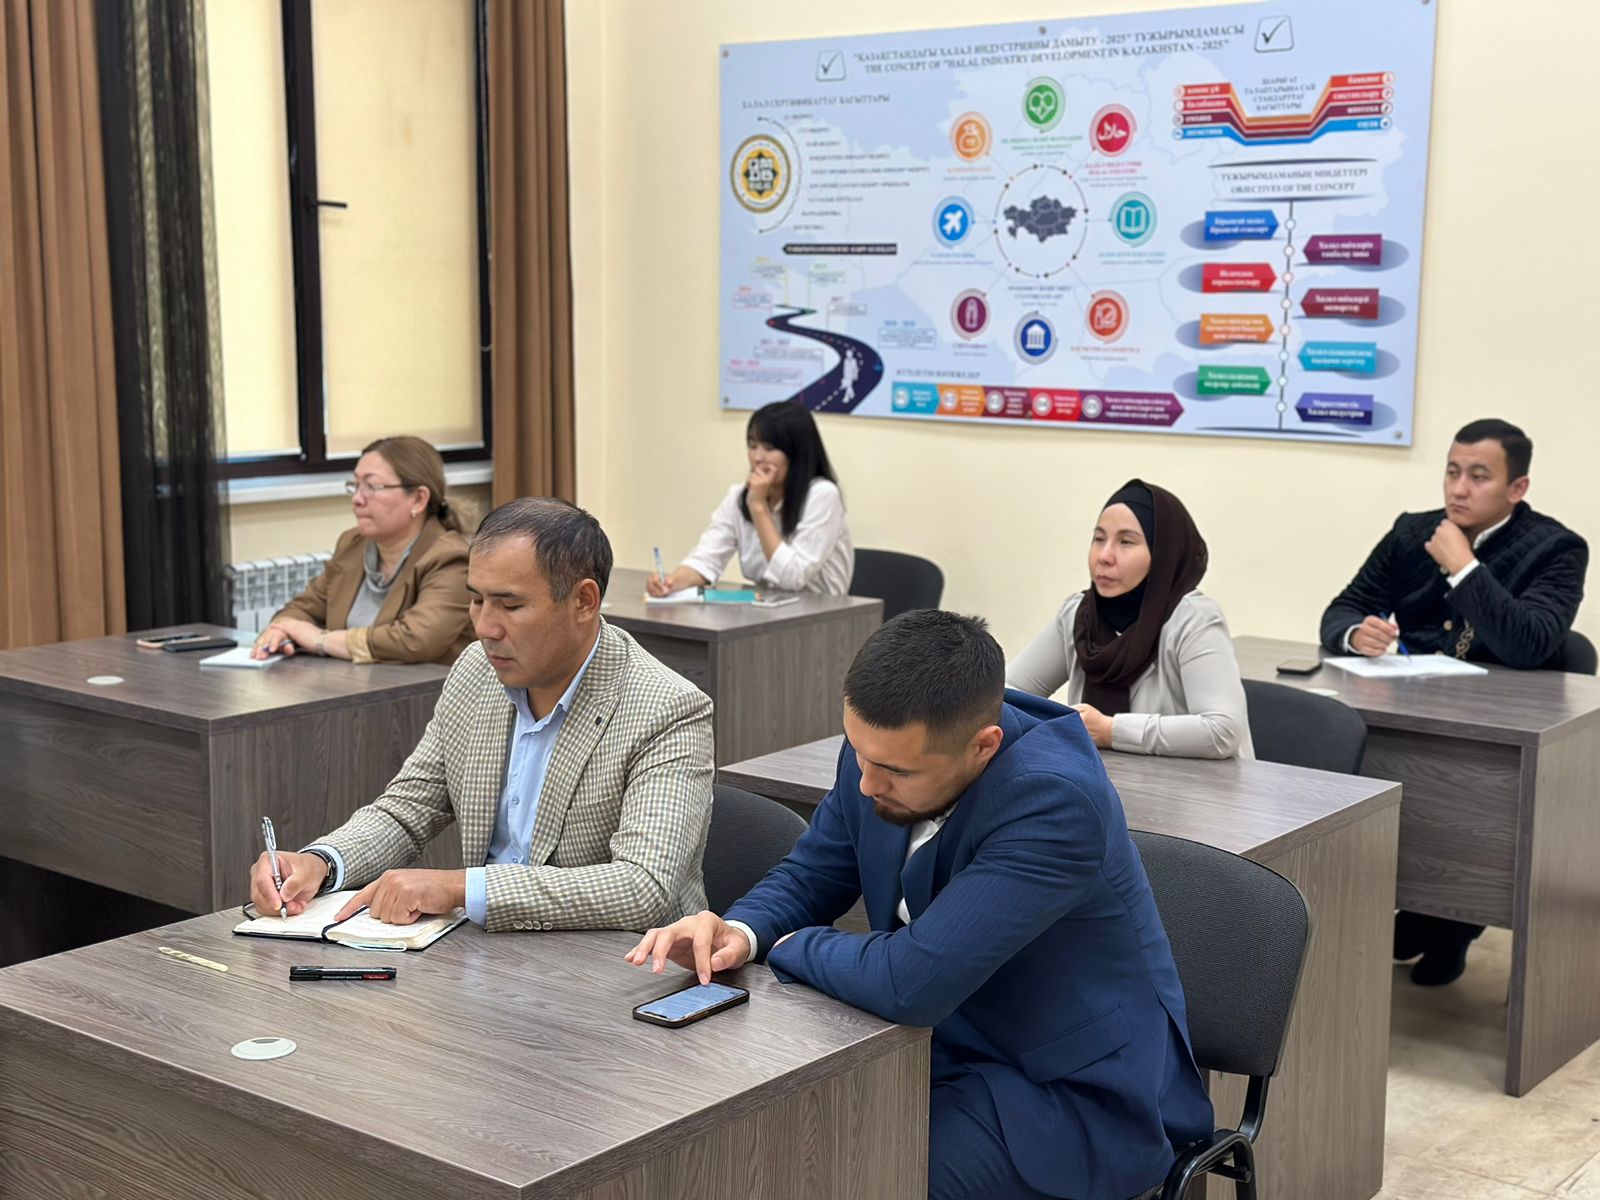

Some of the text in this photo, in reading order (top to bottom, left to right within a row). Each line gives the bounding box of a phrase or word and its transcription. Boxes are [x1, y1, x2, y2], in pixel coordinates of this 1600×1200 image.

[866, 64, 881, 73] THE
[885, 61, 926, 72] CONCEPT
[928, 61, 940, 70] OF
[981, 54, 1027, 66] INDUSTRY
[1031, 48, 1105, 63] DEVELOPMENT
[1108, 47, 1119, 57] IN
[1122, 42, 1193, 56] KAZAKHSTAN
[1230, 184, 1281, 194] OBJECTIVES
[1314, 181, 1355, 191] CONCEPT
